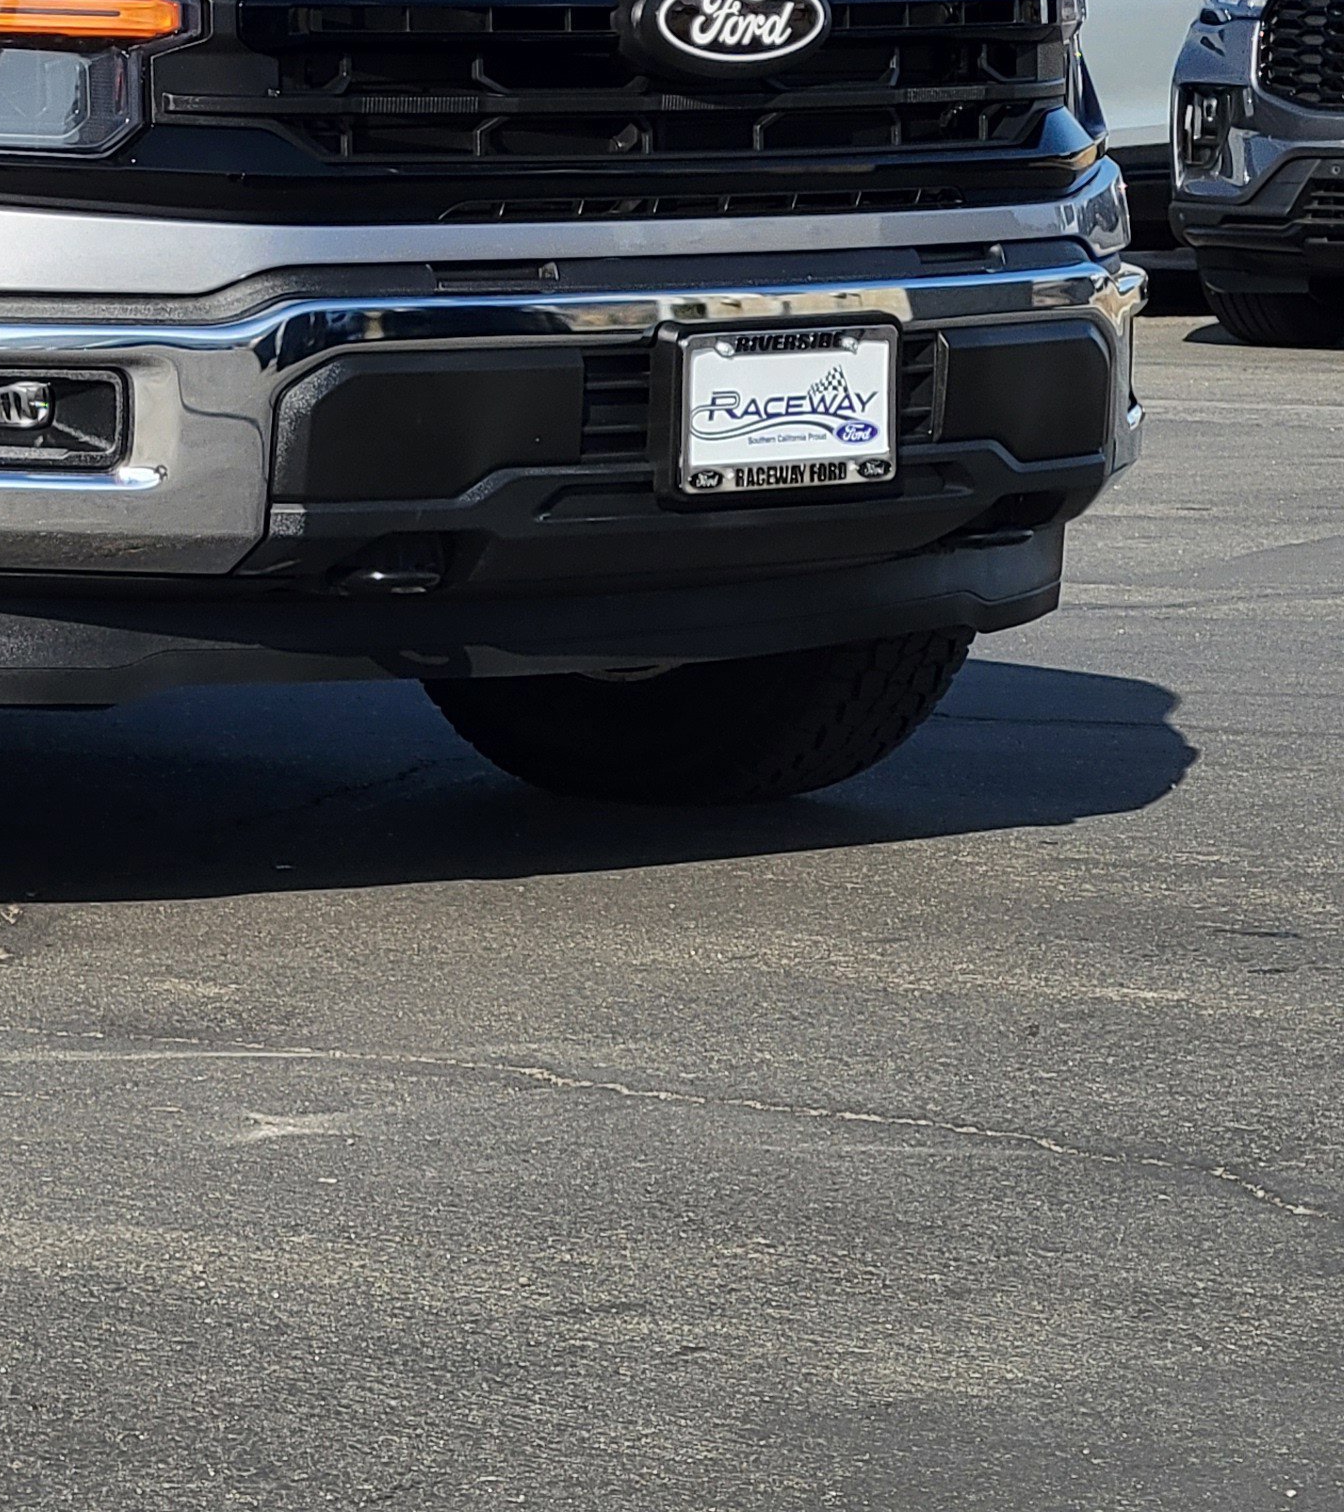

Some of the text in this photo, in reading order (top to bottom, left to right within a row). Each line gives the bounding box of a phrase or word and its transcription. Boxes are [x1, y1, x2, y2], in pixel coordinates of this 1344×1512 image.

[707, 390, 879, 422] RACEWAY
[808, 432, 828, 441] Proud
[841, 423, 873, 443] Ford
[735, 463, 806, 488] RACEWAY
[809, 461, 848, 483] FORD
